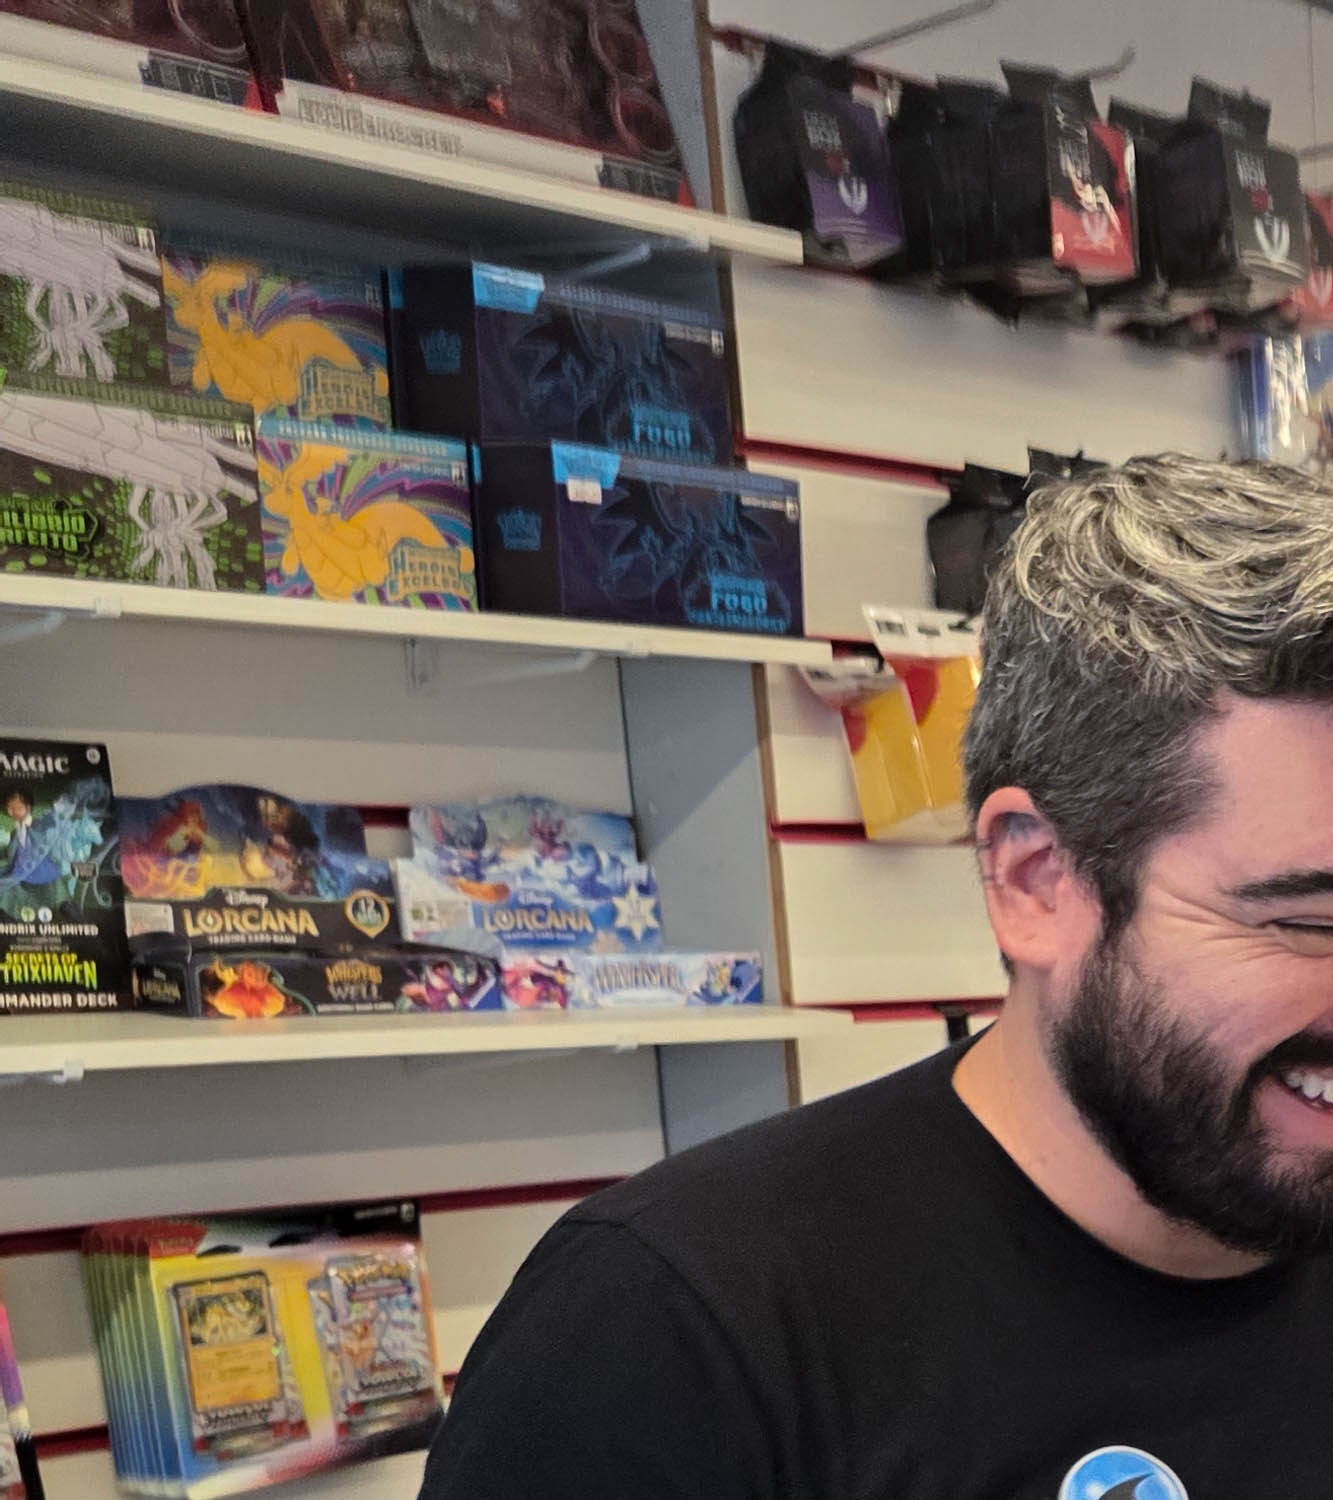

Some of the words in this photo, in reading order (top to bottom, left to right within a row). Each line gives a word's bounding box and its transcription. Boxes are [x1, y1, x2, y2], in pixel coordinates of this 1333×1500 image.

[39, 924, 99, 937] UNLIMITED
[183, 906, 319, 937] LORCANA
[483, 908, 594, 934] LORCANA
[76, 993, 119, 1008] DECK
